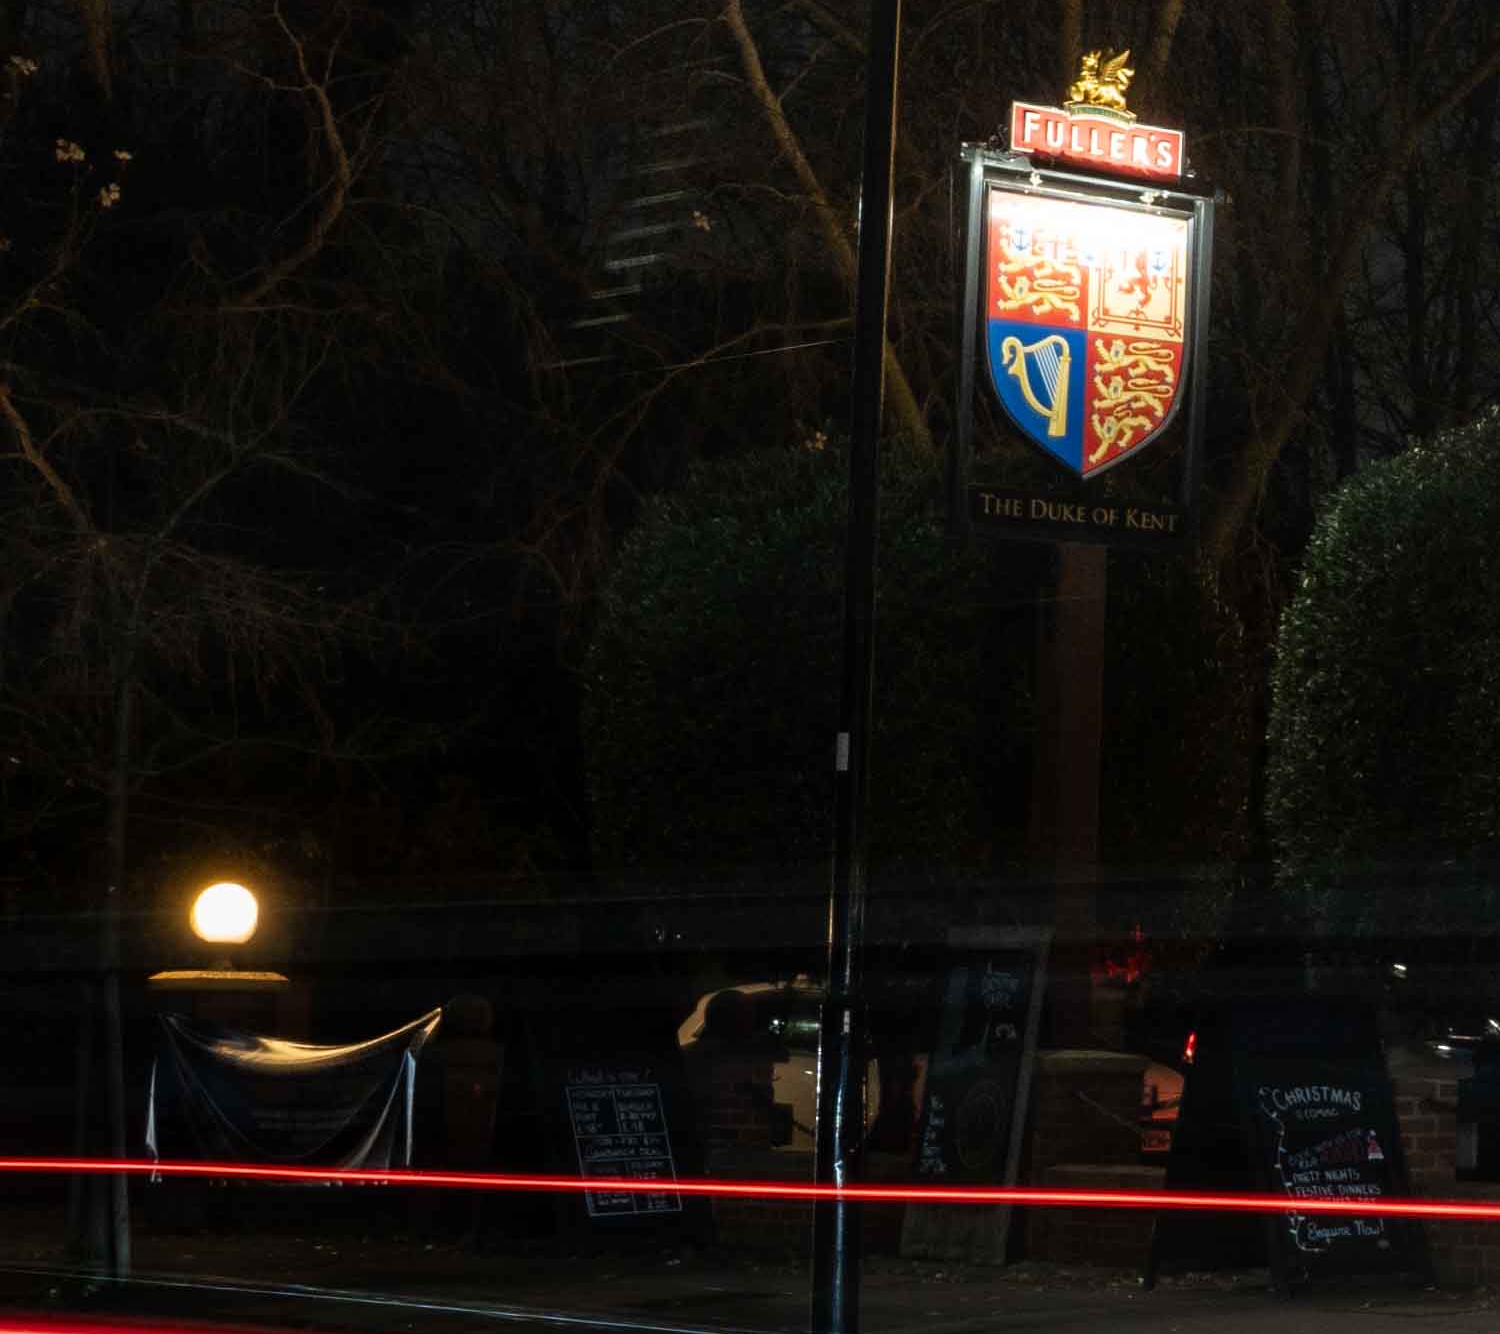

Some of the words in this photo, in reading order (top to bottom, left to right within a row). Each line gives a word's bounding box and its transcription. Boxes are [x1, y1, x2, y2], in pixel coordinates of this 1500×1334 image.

[1023, 110, 1174, 168] FULLER'S
[979, 492, 1024, 516] THE
[1031, 498, 1087, 524] DUKE
[1092, 506, 1121, 526] OF
[1125, 507, 1179, 532] KENT
[1271, 1085, 1362, 1112] CHRISTMAS
